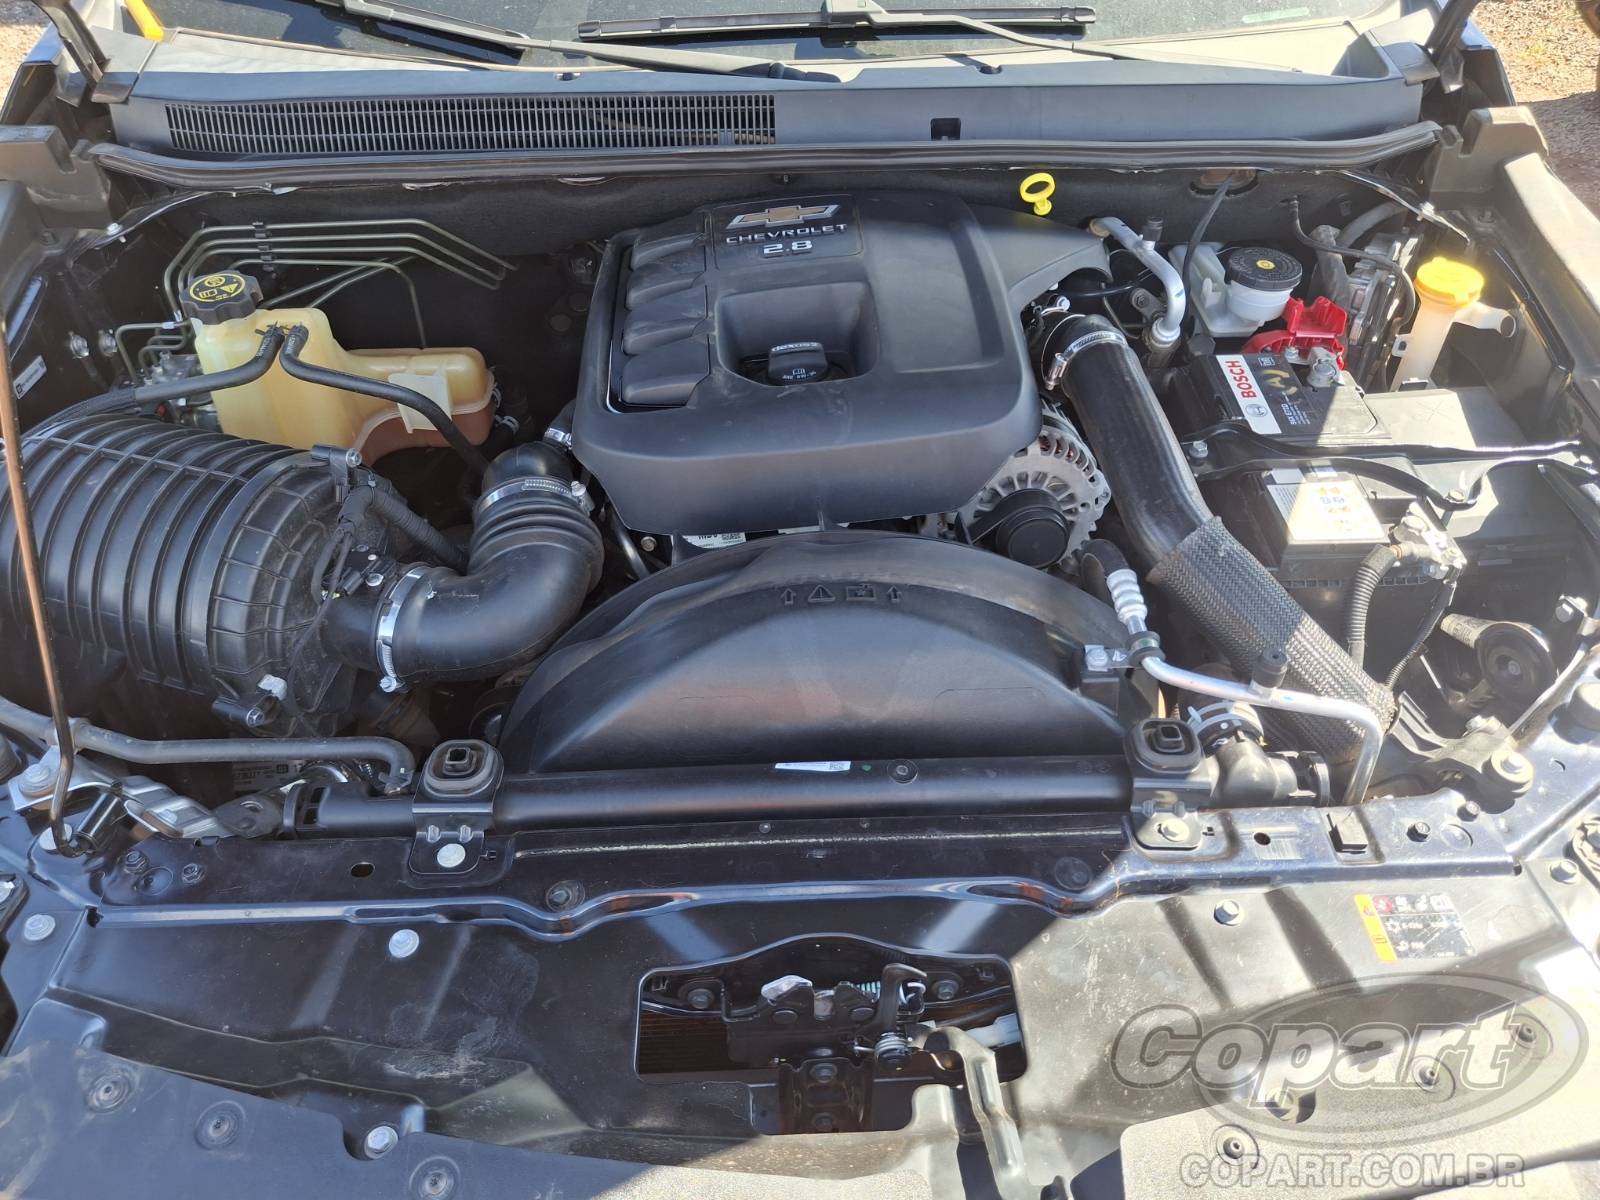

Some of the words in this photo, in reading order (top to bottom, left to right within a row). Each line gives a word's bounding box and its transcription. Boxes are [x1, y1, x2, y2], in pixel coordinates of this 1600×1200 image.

[726, 224, 847, 244] CHEVROLET
[763, 240, 813, 256] 2.8
[1224, 360, 1257, 398] BOSCH
